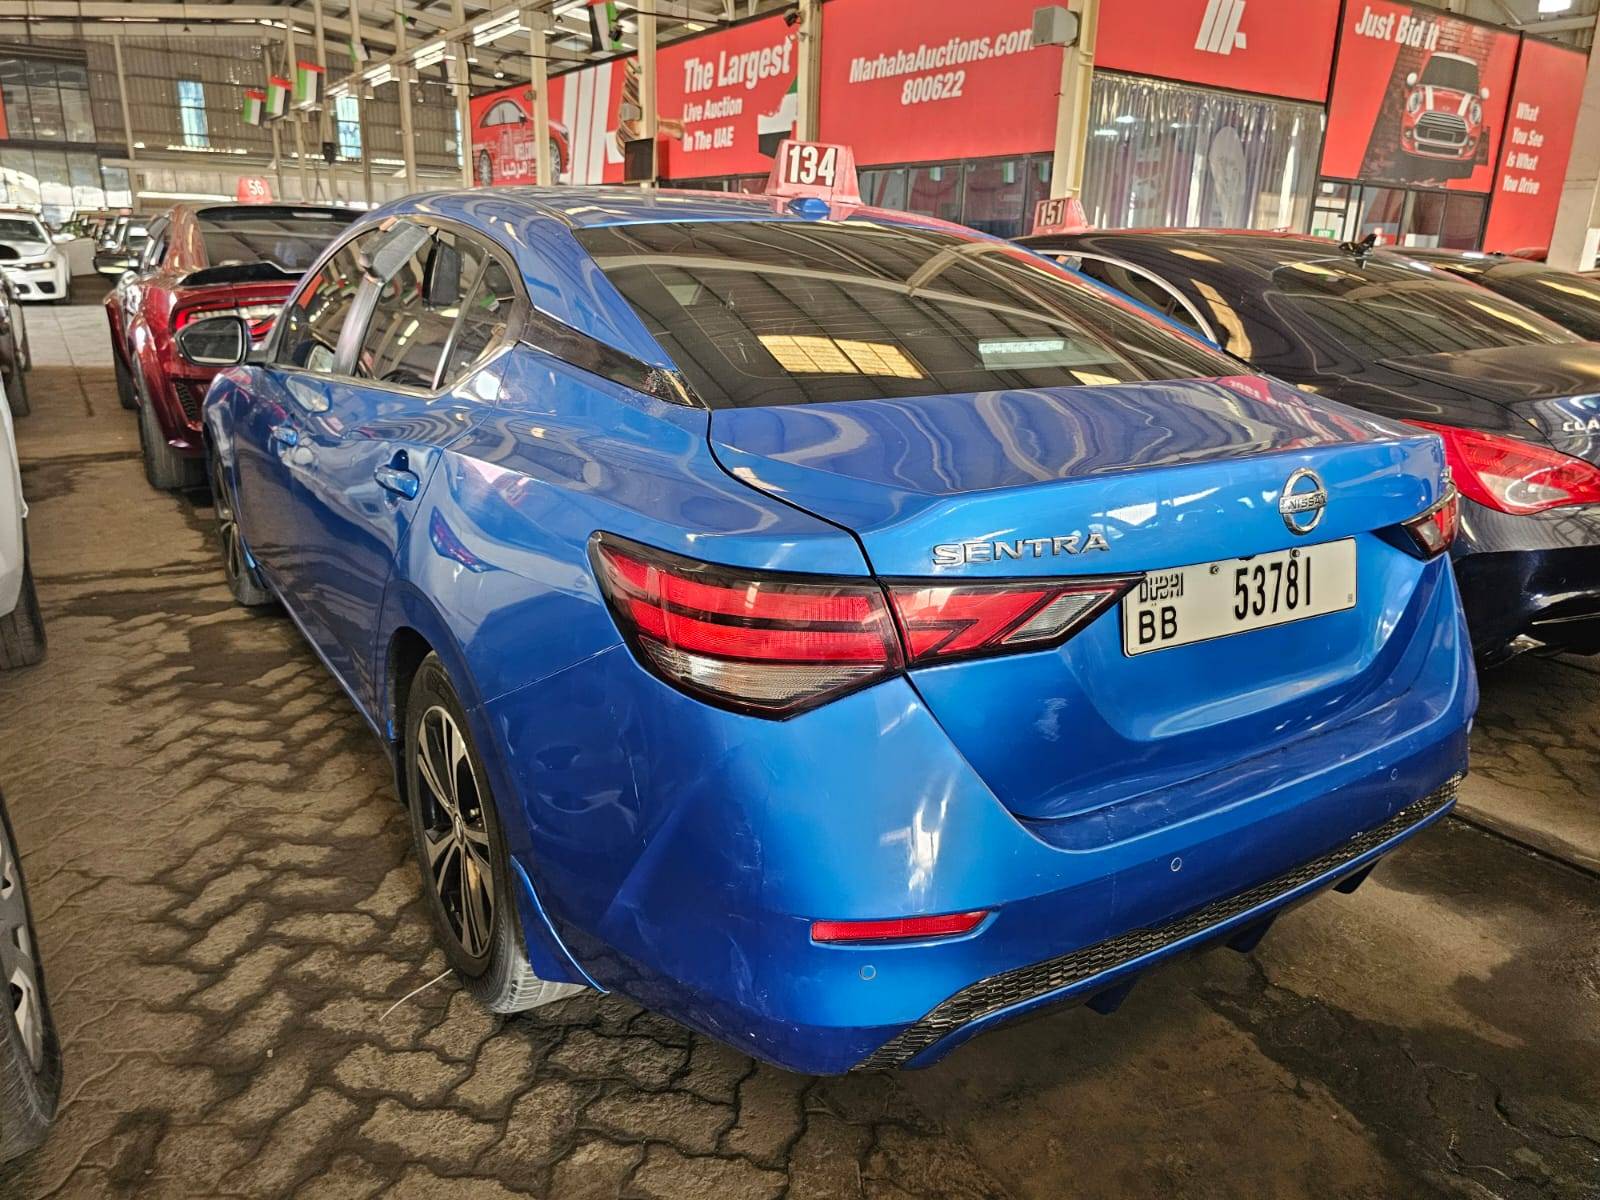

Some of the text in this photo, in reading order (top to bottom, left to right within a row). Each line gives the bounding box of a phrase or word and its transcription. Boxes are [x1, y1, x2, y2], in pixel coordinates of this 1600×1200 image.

[1356, 7, 1441, 52] Just Bid It
[683, 37, 792, 94] The Largest
[900, 70, 966, 106] 800622
[683, 96, 743, 123] Live Auction
[1516, 101, 1539, 123] What
[683, 126, 735, 152] In The UAE
[1510, 126, 1543, 149] You See
[789, 146, 837, 185] 134
[1505, 151, 1539, 172] Is What
[248, 179, 265, 197] 56
[1501, 175, 1540, 196] You Drive
[1041, 201, 1065, 226] 151
[932, 533, 1111, 567] SENTRA
[1234, 556, 1312, 621] 53781
[1139, 606, 1178, 645] BB
